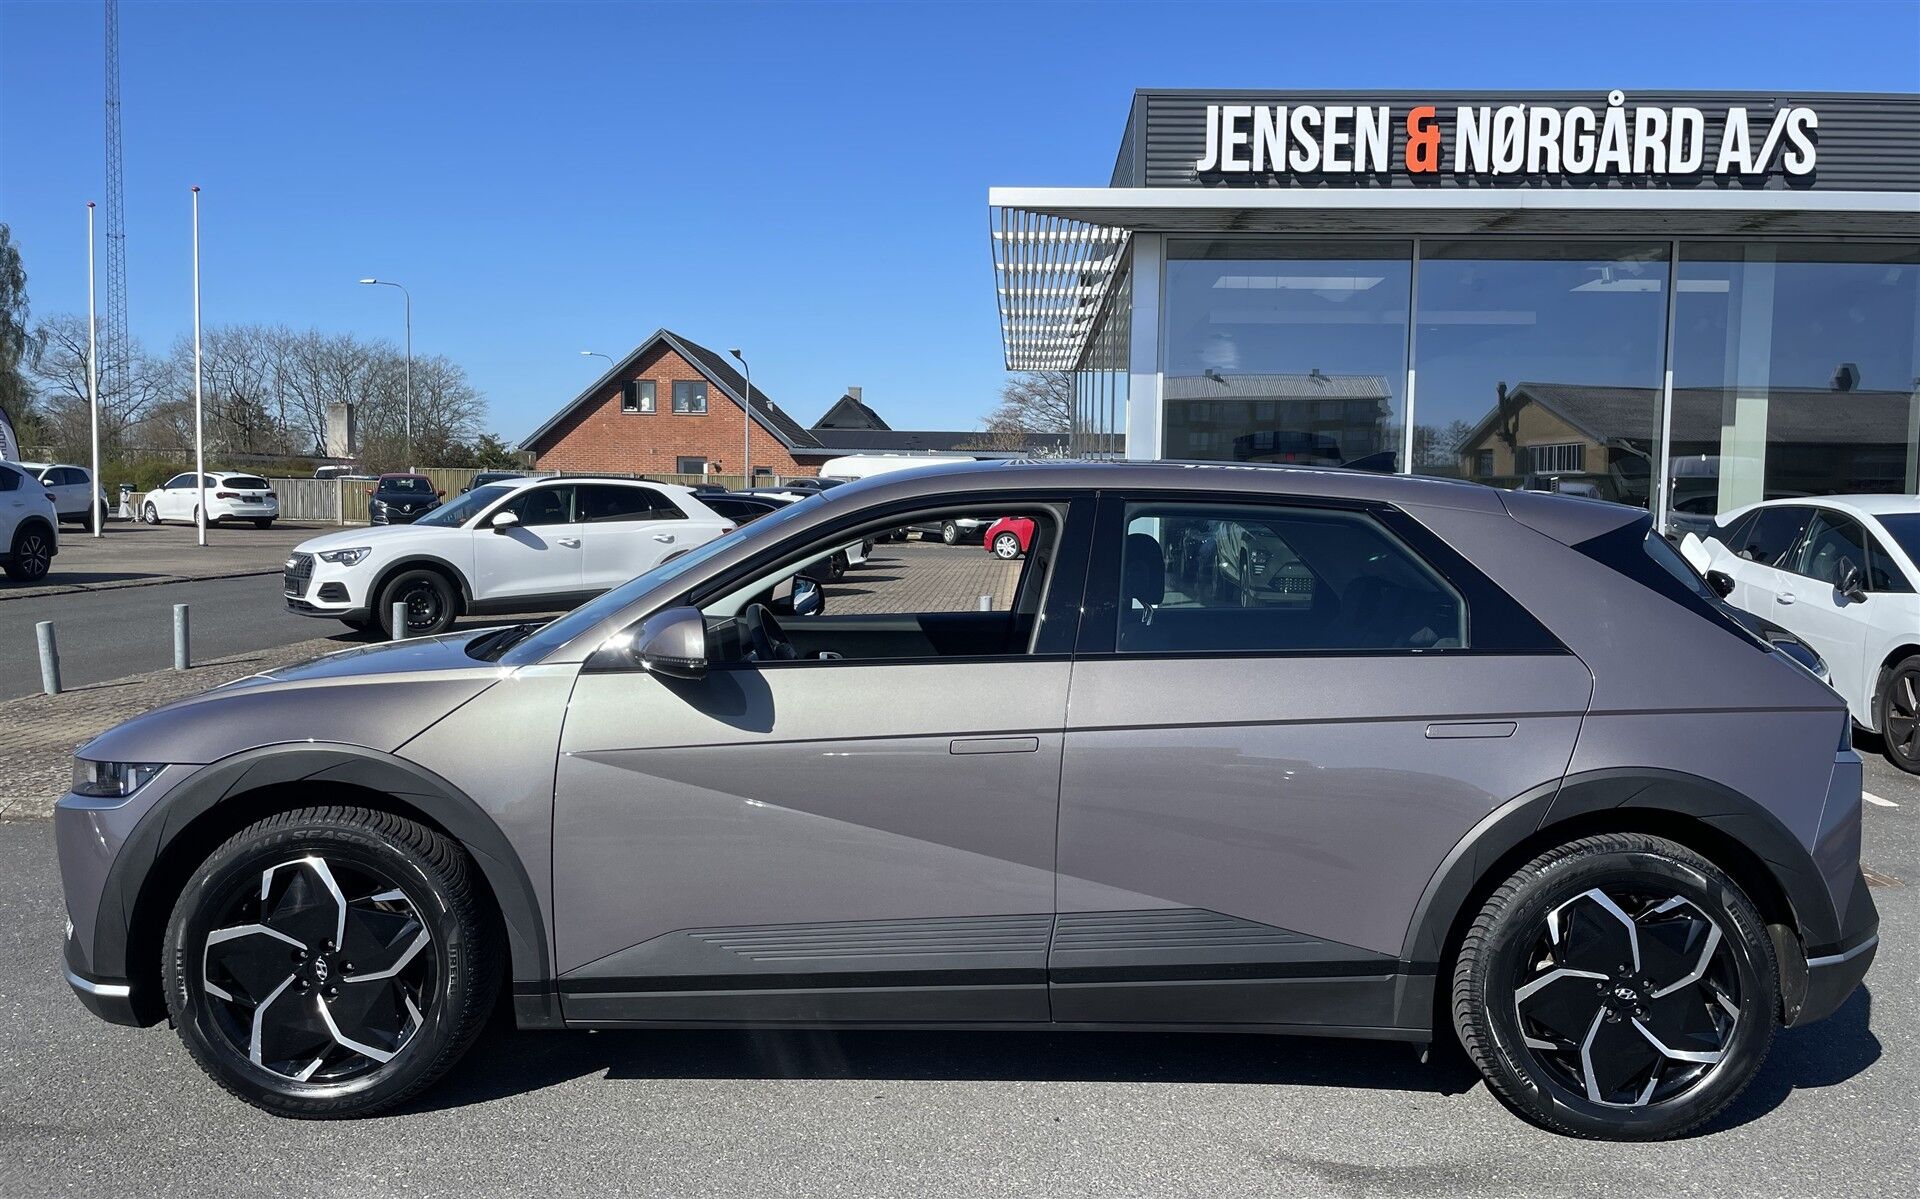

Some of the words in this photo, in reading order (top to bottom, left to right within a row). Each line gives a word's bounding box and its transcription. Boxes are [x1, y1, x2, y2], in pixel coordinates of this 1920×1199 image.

[1197, 105, 1390, 172] JENSEN
[1405, 106, 1441, 172] &
[1454, 90, 1704, 175] NØRGÅRD
[1716, 107, 1818, 174] A/S
